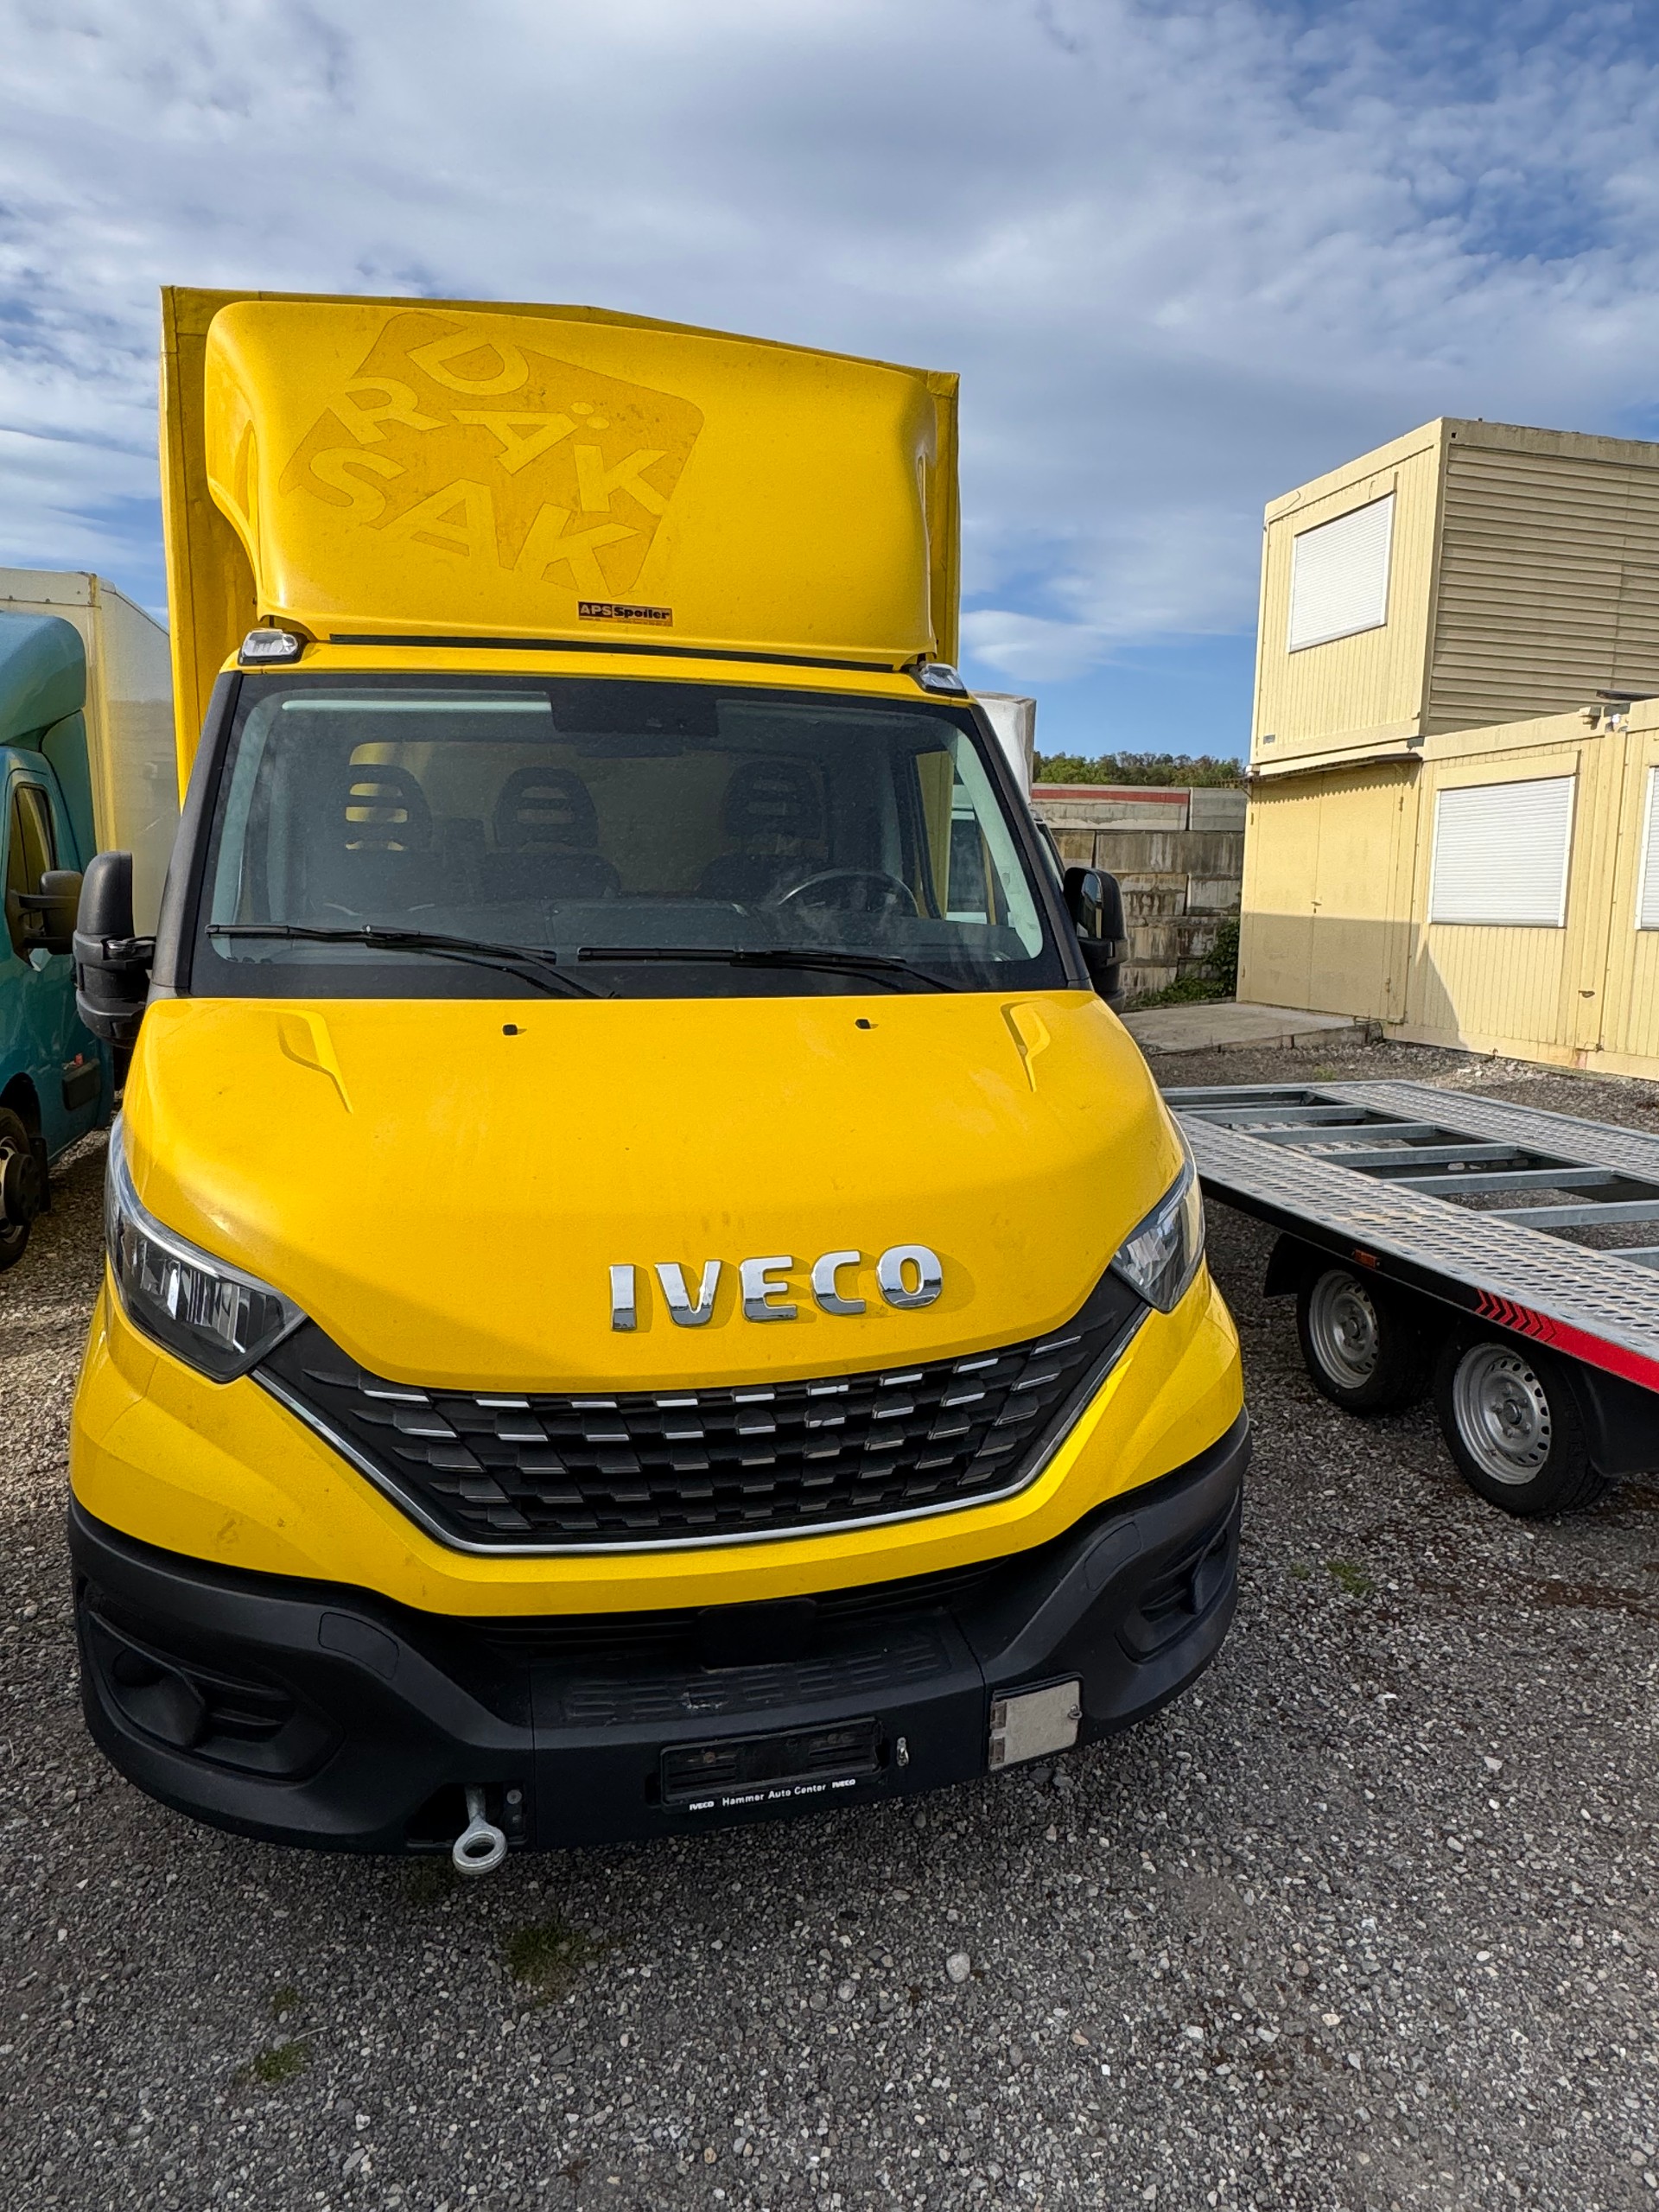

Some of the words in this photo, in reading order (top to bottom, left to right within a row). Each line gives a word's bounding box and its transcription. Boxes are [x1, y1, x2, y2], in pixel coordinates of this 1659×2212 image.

[580, 604, 612, 616] APS
[613, 607, 670, 619] Spoiler
[609, 1243, 943, 1332] IVECO
[689, 1801, 715, 1811] IVECO
[721, 1794, 765, 1807] Hammer
[767, 1790, 791, 1799] Auto
[794, 1783, 827, 1795] Center
